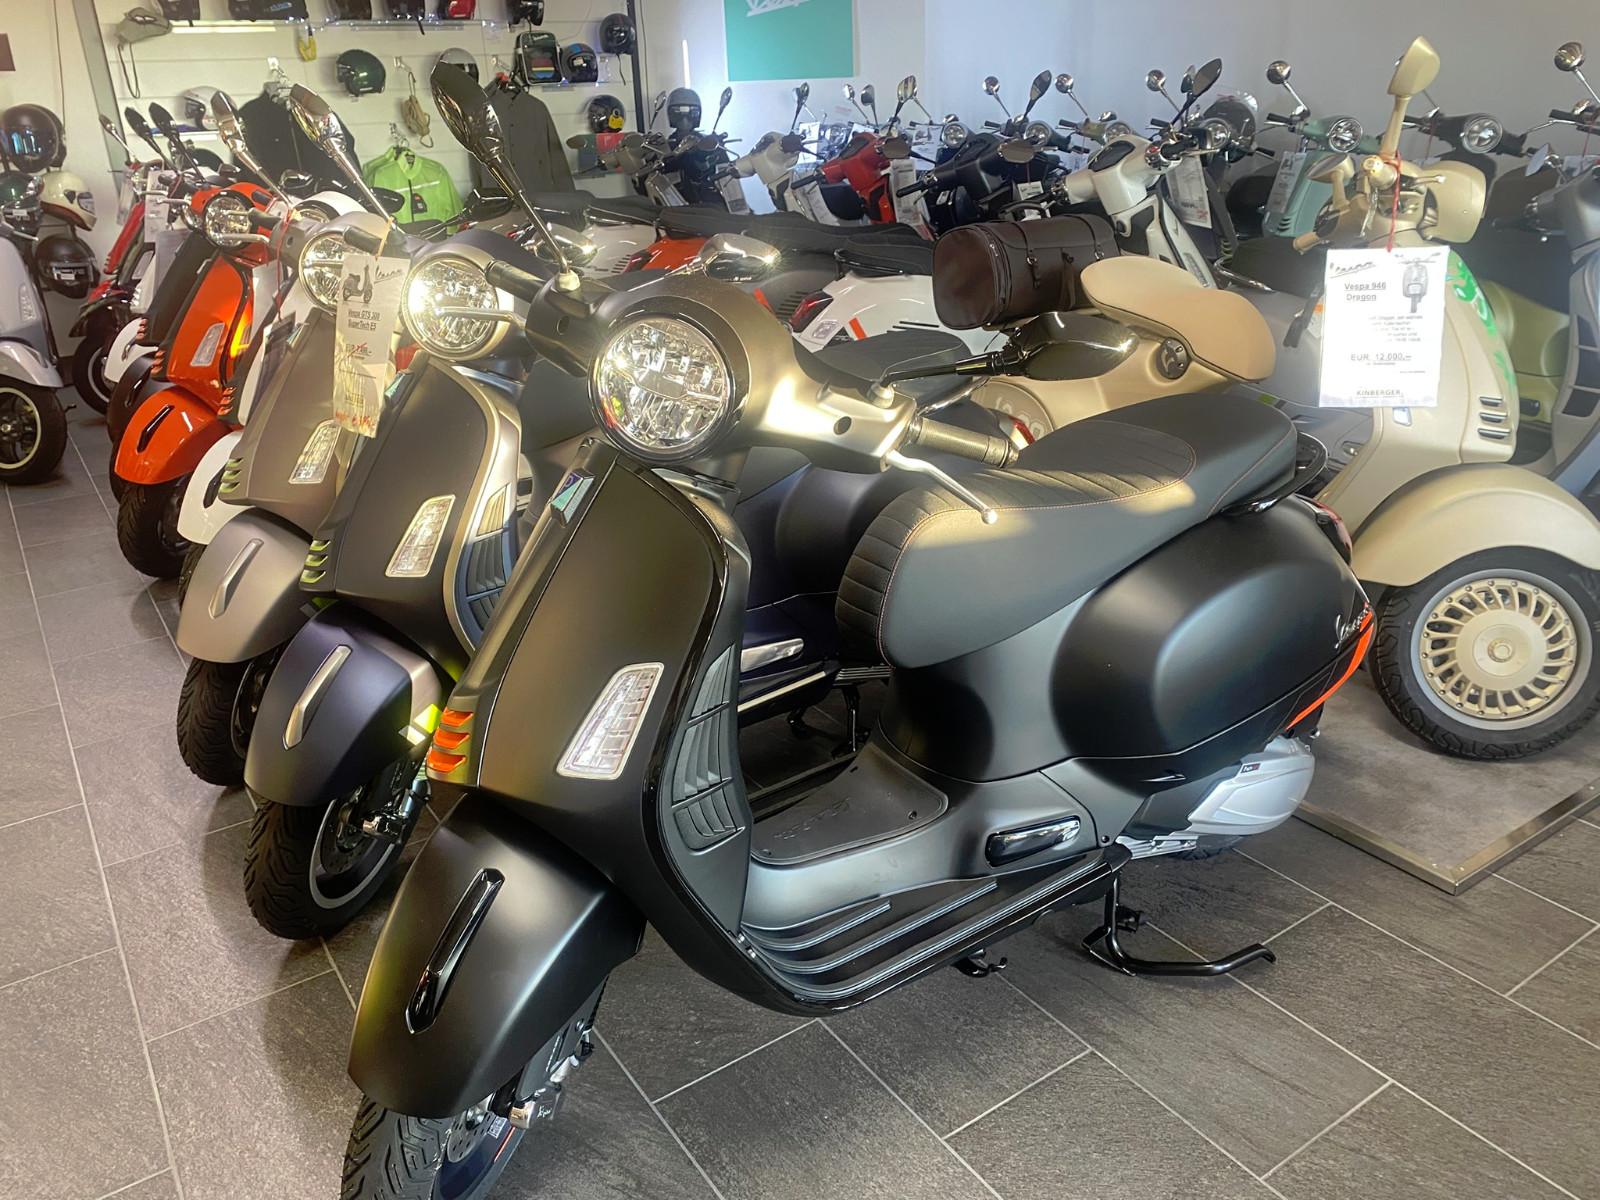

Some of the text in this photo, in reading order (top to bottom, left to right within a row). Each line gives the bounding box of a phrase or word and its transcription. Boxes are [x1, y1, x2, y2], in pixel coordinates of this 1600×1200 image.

[1344, 281, 1386, 292] Vespa 946
[1346, 293, 1377, 302] Dragon
[1350, 353, 1369, 361] EUR
